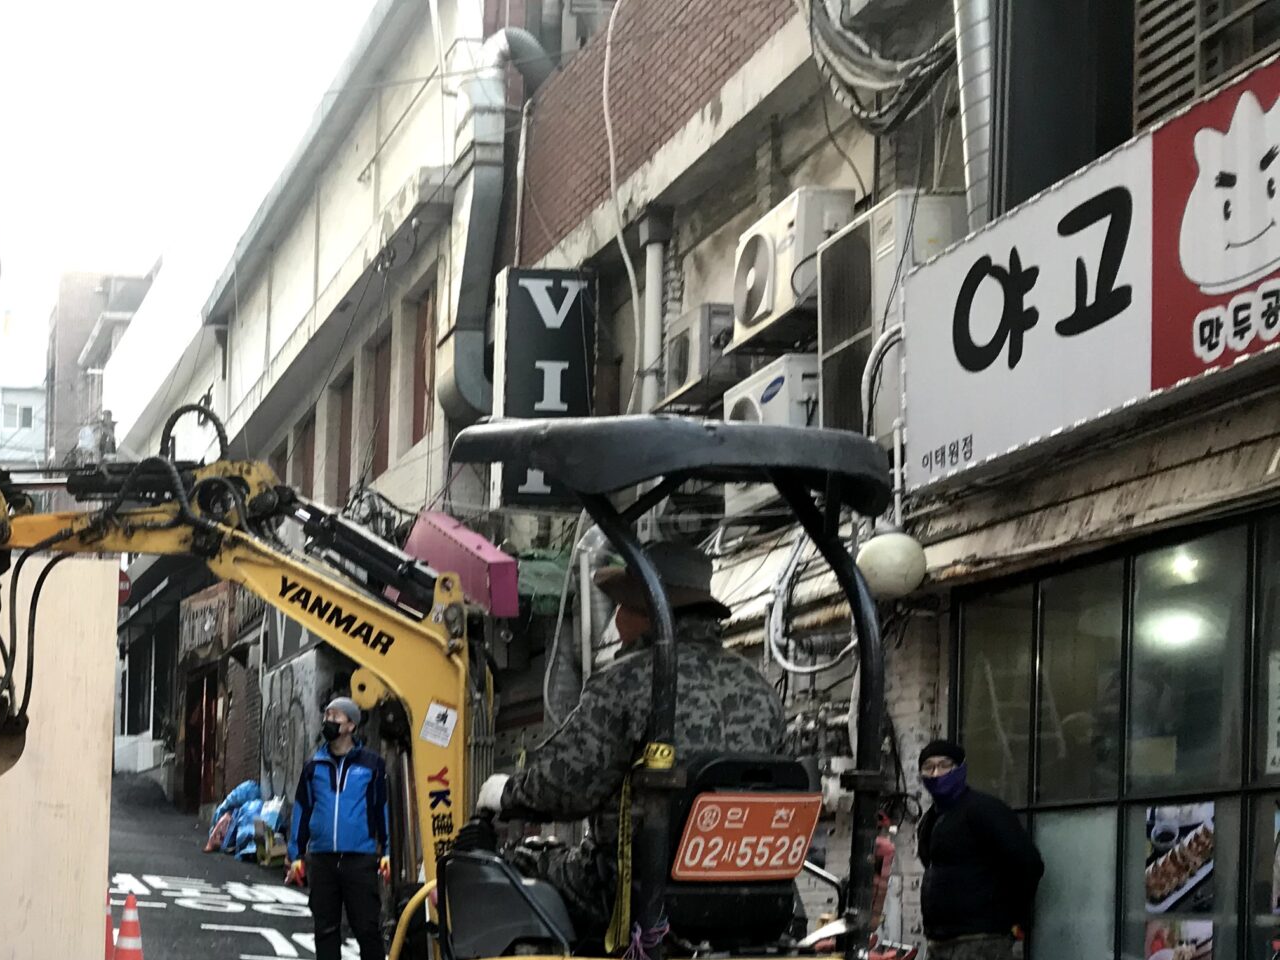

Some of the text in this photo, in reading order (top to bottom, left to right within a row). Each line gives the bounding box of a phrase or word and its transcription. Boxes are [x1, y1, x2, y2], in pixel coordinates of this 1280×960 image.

[952, 186, 1133, 372] 야고
[921, 433, 973, 474] 이태원점
[278, 575, 395, 656] YANMAR
